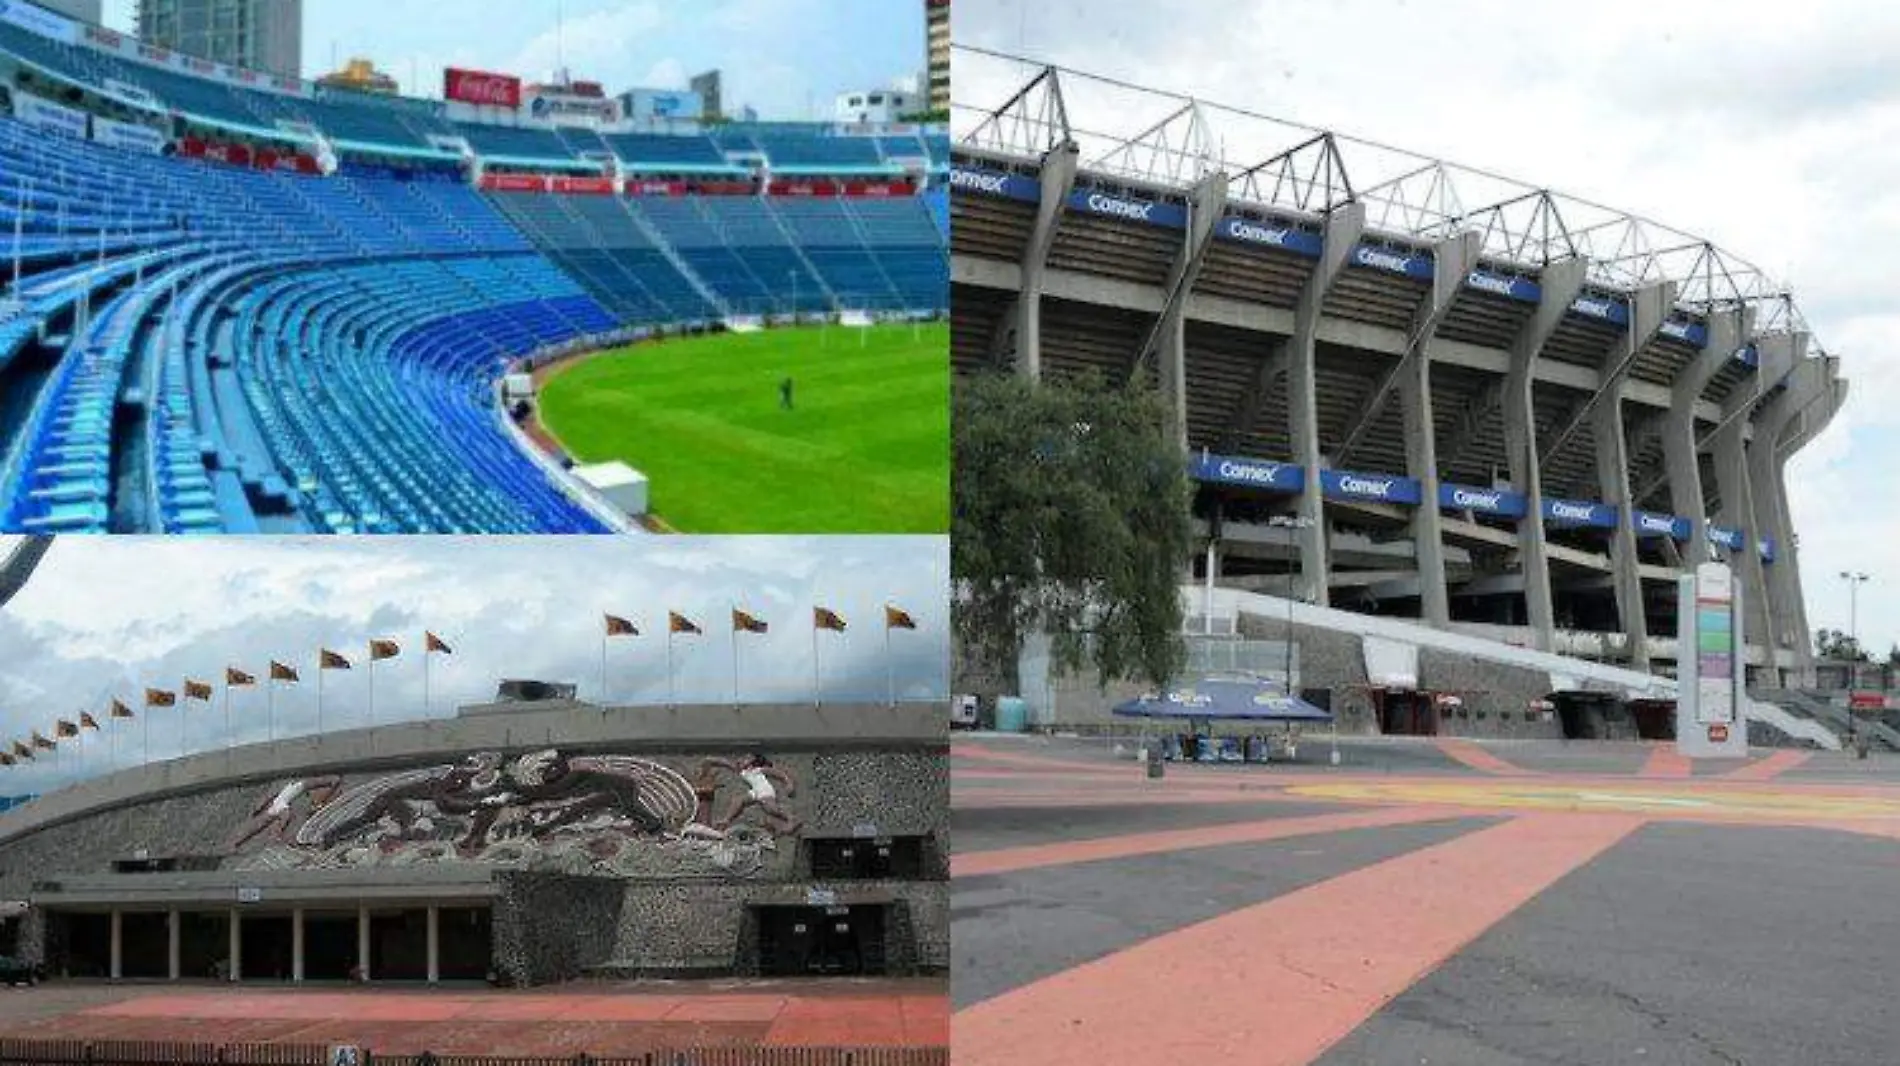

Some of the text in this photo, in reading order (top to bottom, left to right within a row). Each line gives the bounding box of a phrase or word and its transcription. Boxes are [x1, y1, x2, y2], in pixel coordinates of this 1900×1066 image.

[1089, 193, 1152, 217] Comex
[1231, 222, 1287, 244] Comex
[1358, 247, 1410, 271] Comex
[1220, 461, 1277, 482] Comex
[1340, 476, 1393, 495] Comex
[1454, 490, 1500, 509] Comex
[1552, 502, 1594, 520] Comex
